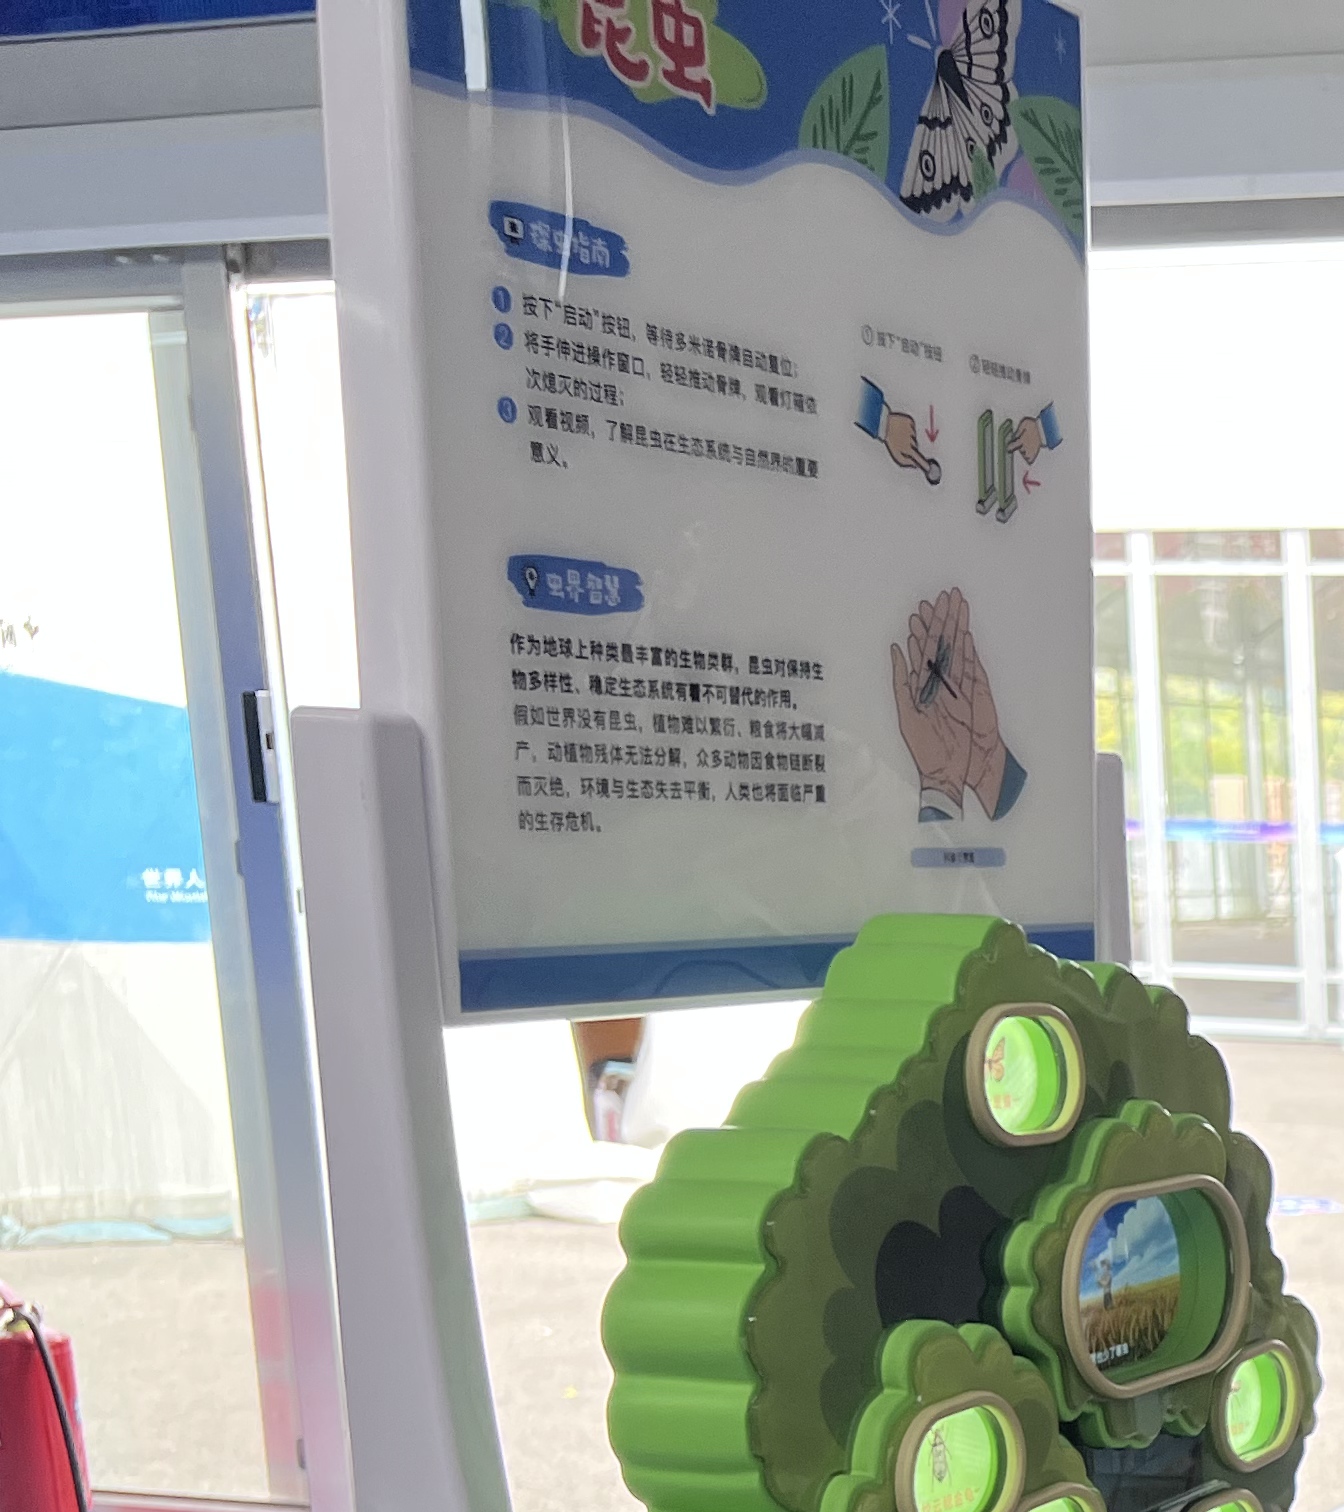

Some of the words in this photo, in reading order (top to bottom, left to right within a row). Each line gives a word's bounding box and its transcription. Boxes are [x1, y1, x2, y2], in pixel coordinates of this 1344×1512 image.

[518, 810, 603, 834] 的生存危机。
